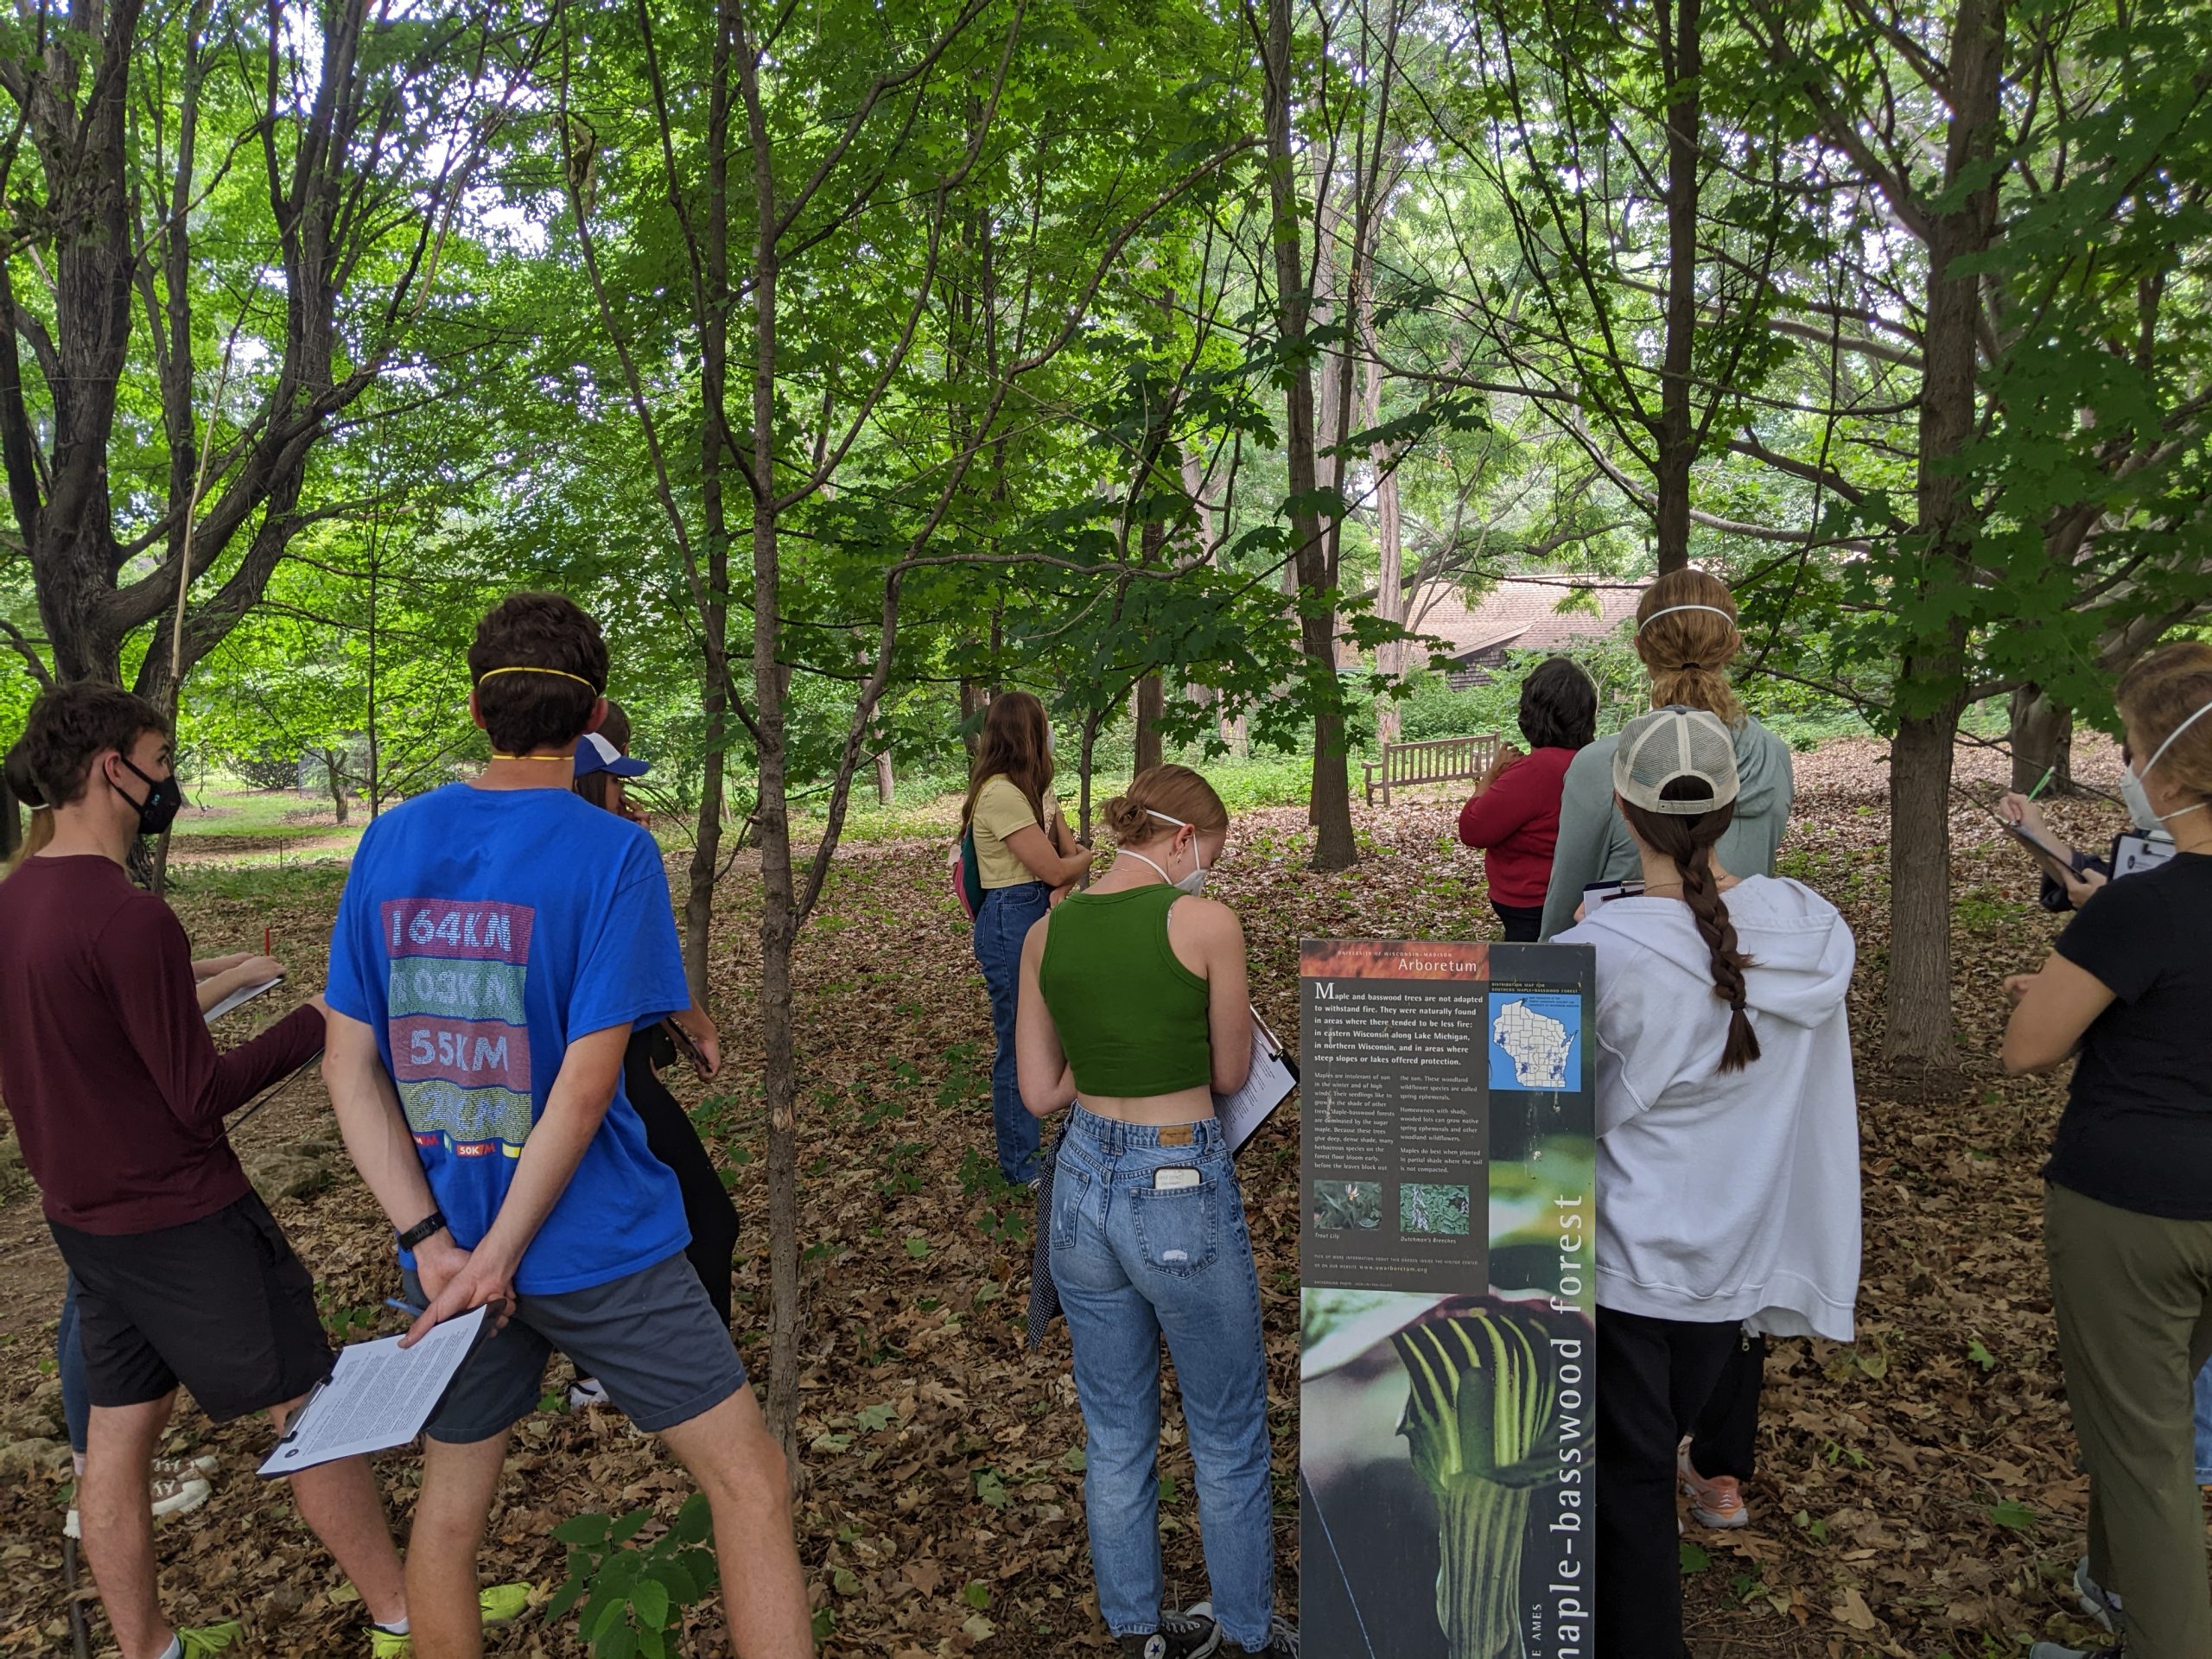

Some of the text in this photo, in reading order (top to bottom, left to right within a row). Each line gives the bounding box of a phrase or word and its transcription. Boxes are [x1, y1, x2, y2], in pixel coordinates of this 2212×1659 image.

[1398, 958, 1477, 971] Arboretum
[1314, 982, 1349, 1001] Maple
[1453, 995, 1483, 1004] adapted
[1380, 1006, 1396, 1014] They
[1419, 1007, 1452, 1016] naturally
[1391, 1031, 1411, 1039] along
[410, 1030, 508, 1071] 55KM
[1357, 1042, 1396, 1051] Wisconsin,
[1314, 1053, 1333, 1063] steep
[1336, 1054, 1357, 1064] slopes
[1421, 1057, 1460, 1066] protection.
[1348, 1090, 1373, 1099] seedlings
[1418, 1125, 1449, 1134] ephemerals
[1550, 1194, 1582, 1314] forest
[1531, 1604, 1541, 1641] AMES
